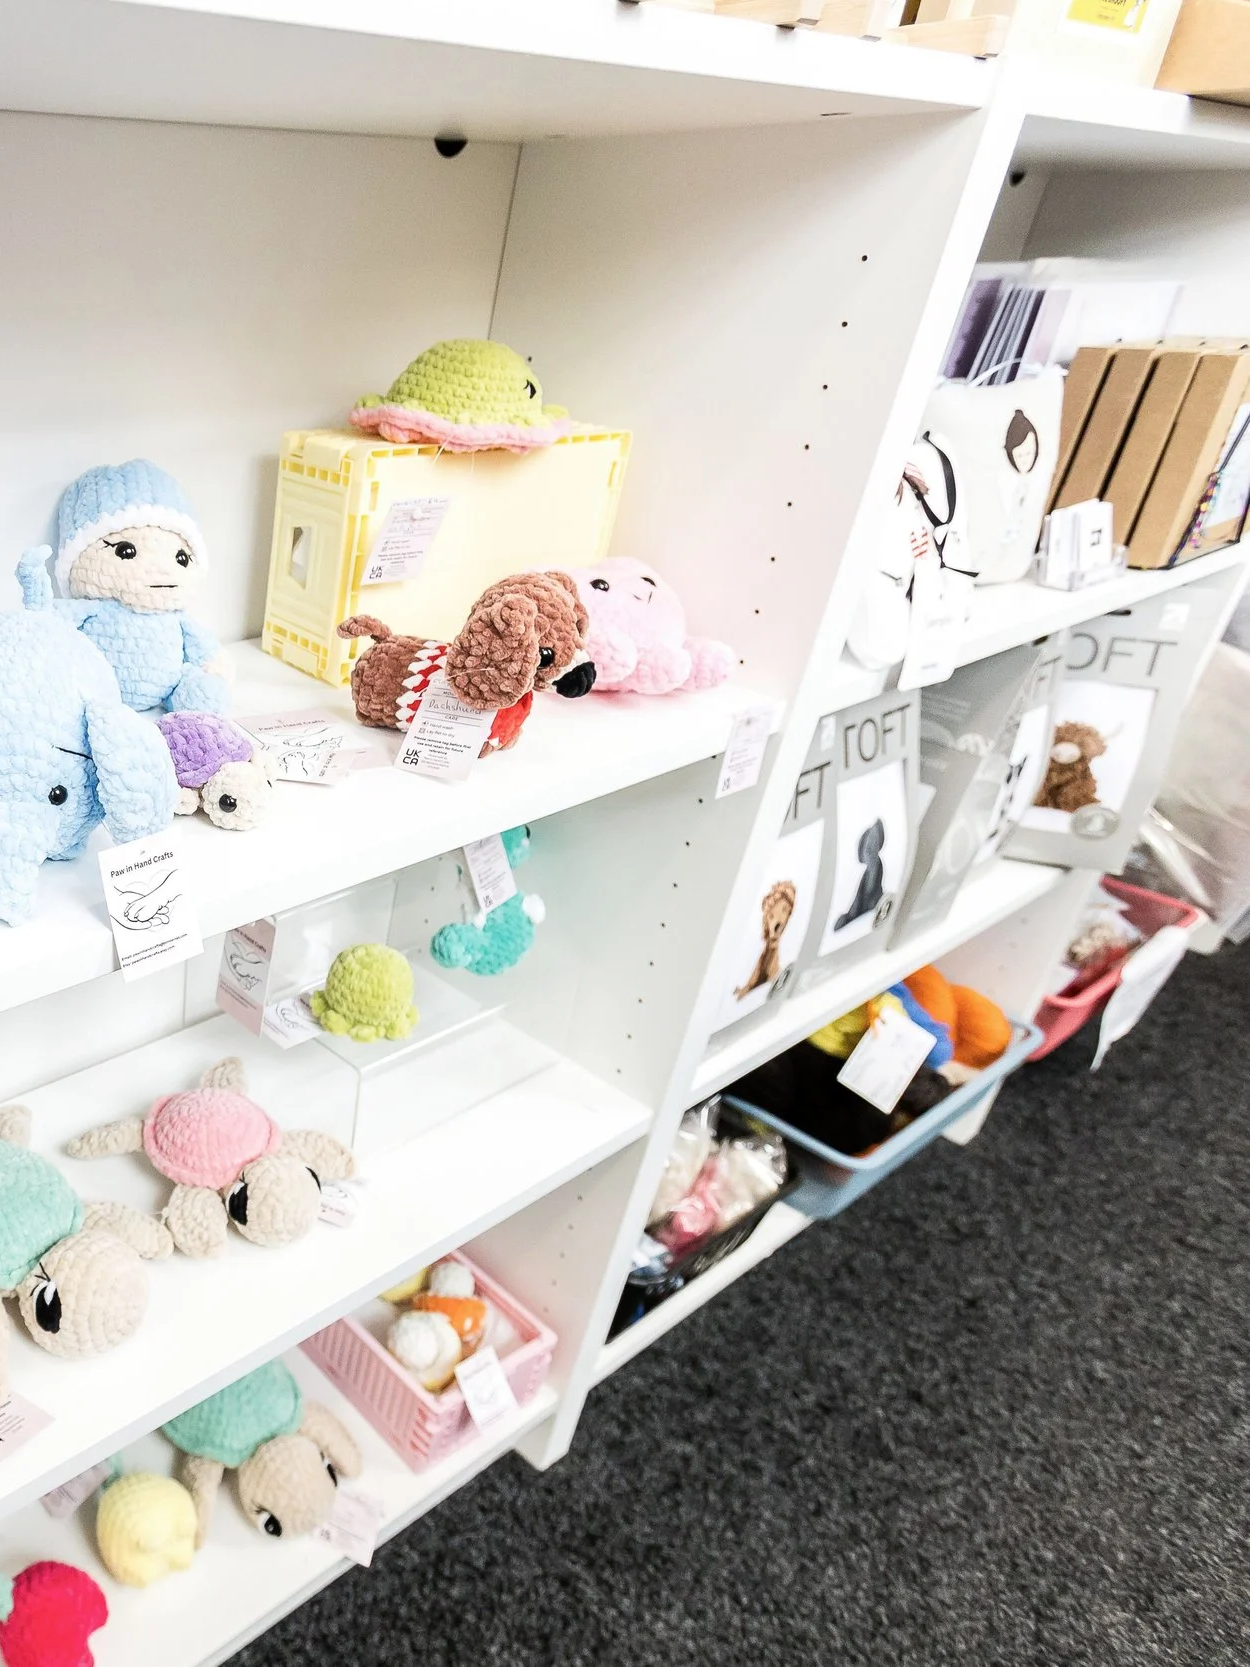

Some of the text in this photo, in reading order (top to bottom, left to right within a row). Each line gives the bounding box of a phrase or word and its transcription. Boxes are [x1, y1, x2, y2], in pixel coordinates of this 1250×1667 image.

[1067, 633, 1178, 677] OFT
[402, 756, 418, 766] CA
[406, 748, 421, 758] UK
[110, 869, 124, 878] Paw
[134, 858, 152, 870] Hand
[152, 851, 174, 863] Crafts
